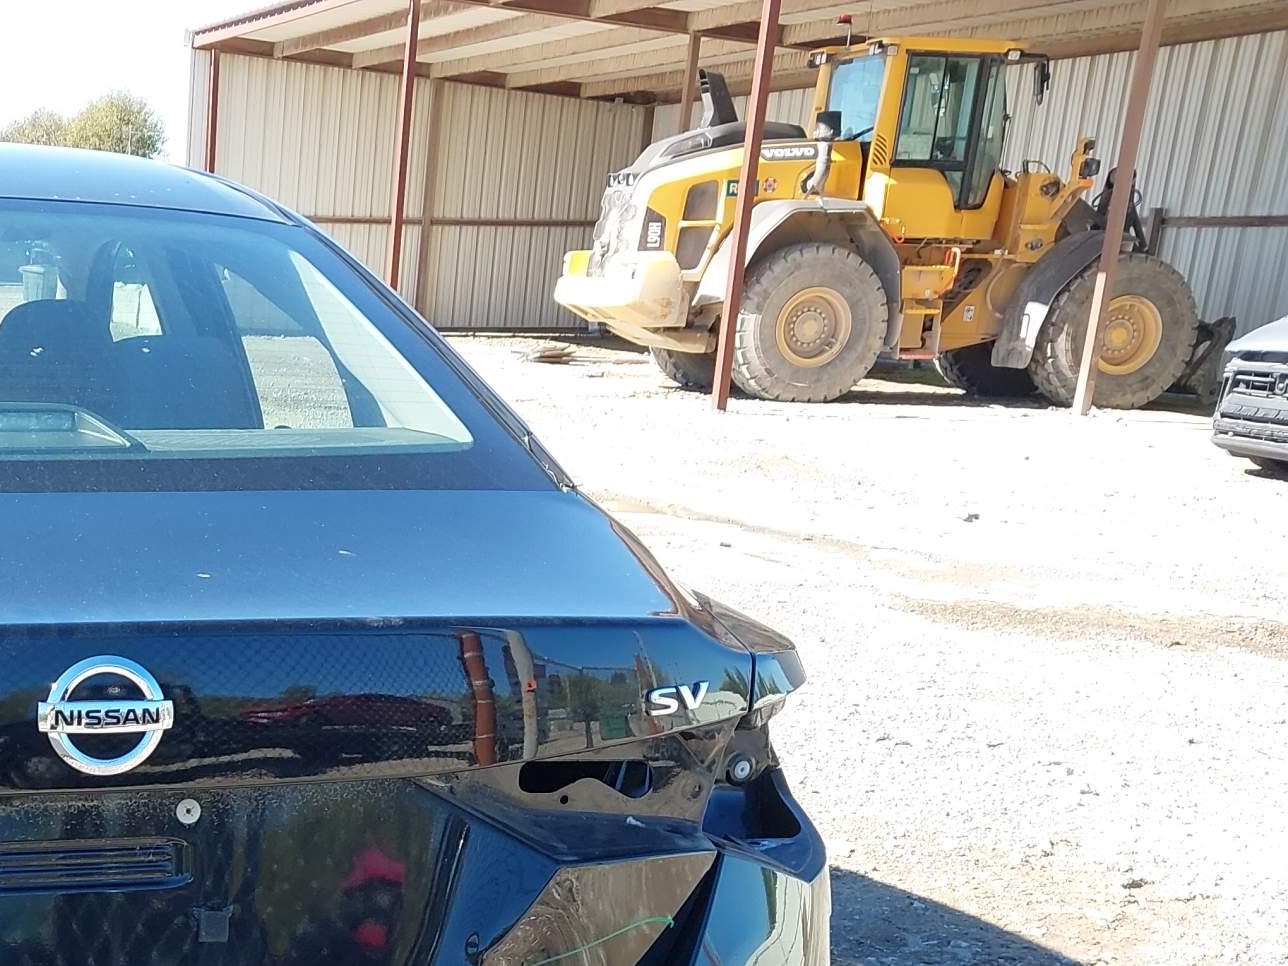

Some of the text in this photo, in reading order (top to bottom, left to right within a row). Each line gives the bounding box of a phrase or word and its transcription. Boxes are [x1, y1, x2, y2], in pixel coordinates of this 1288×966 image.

[762, 147, 815, 157] VOLVO
[648, 681, 710, 716] SV
[53, 706, 161, 727] NISSAN
